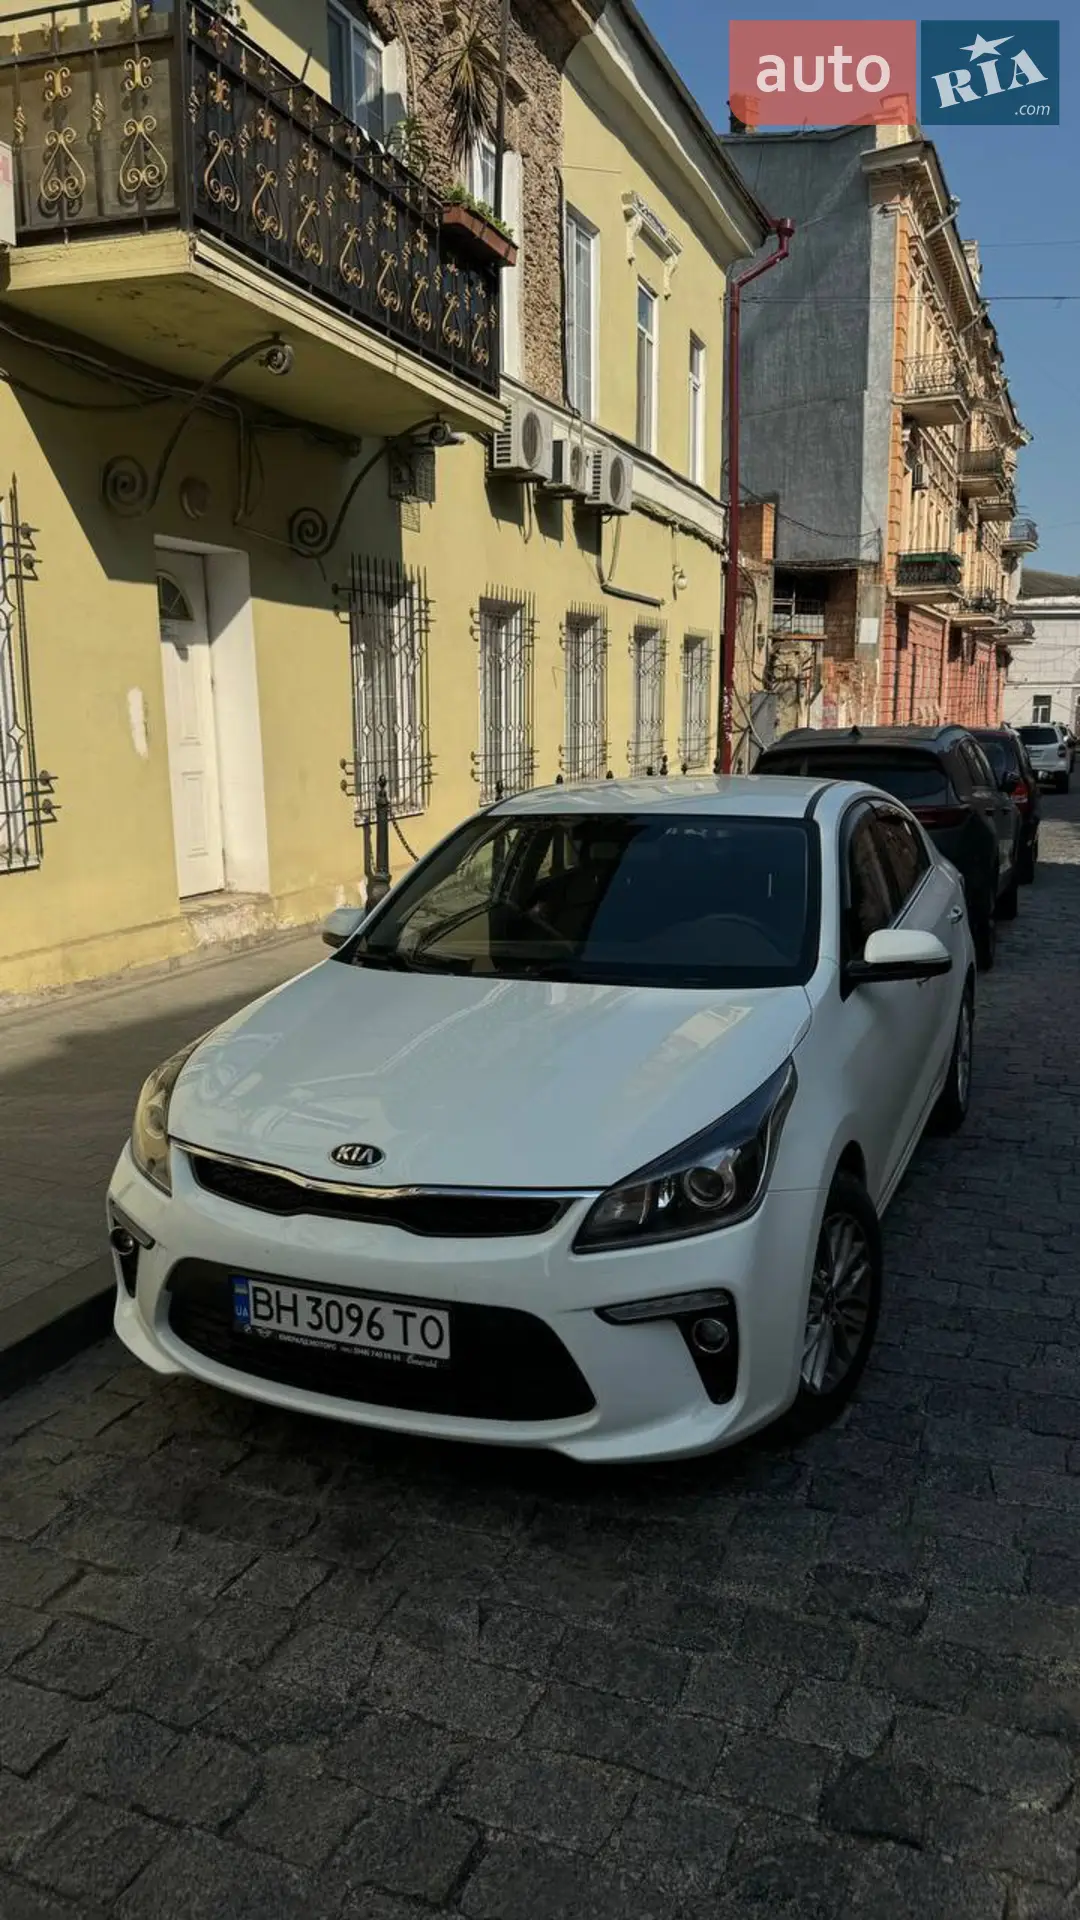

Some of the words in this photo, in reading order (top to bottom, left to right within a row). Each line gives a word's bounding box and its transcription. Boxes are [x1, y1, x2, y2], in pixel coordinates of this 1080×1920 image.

[336, 1146, 374, 1163] KIA
[235, 1303, 249, 1318] UA
[252, 1286, 299, 1327] BH
[305, 1295, 385, 1341] 3096
[392, 1309, 445, 1350] TO
